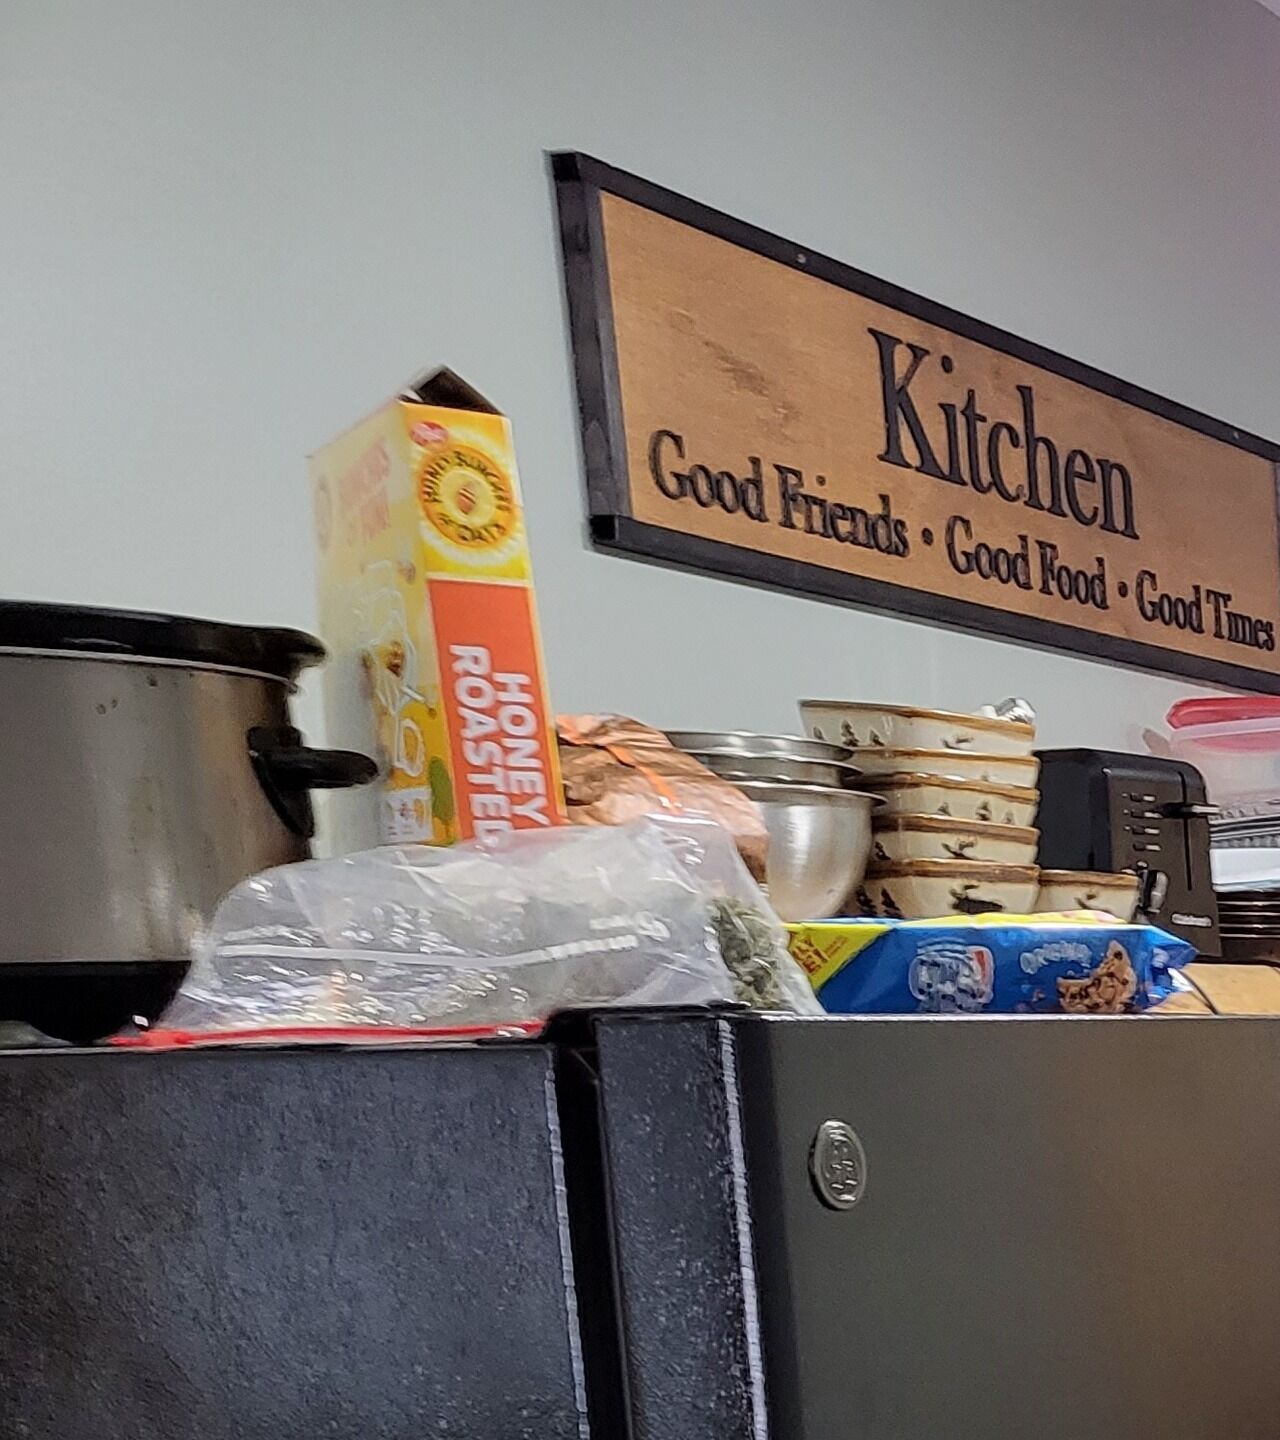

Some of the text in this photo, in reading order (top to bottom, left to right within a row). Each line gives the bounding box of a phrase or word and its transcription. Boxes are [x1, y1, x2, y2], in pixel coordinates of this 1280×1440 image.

[868, 328, 1139, 540] Kitchen
[649, 430, 1276, 652] Good Friends Good Food Good Times
[492, 672, 550, 826] HONEY
